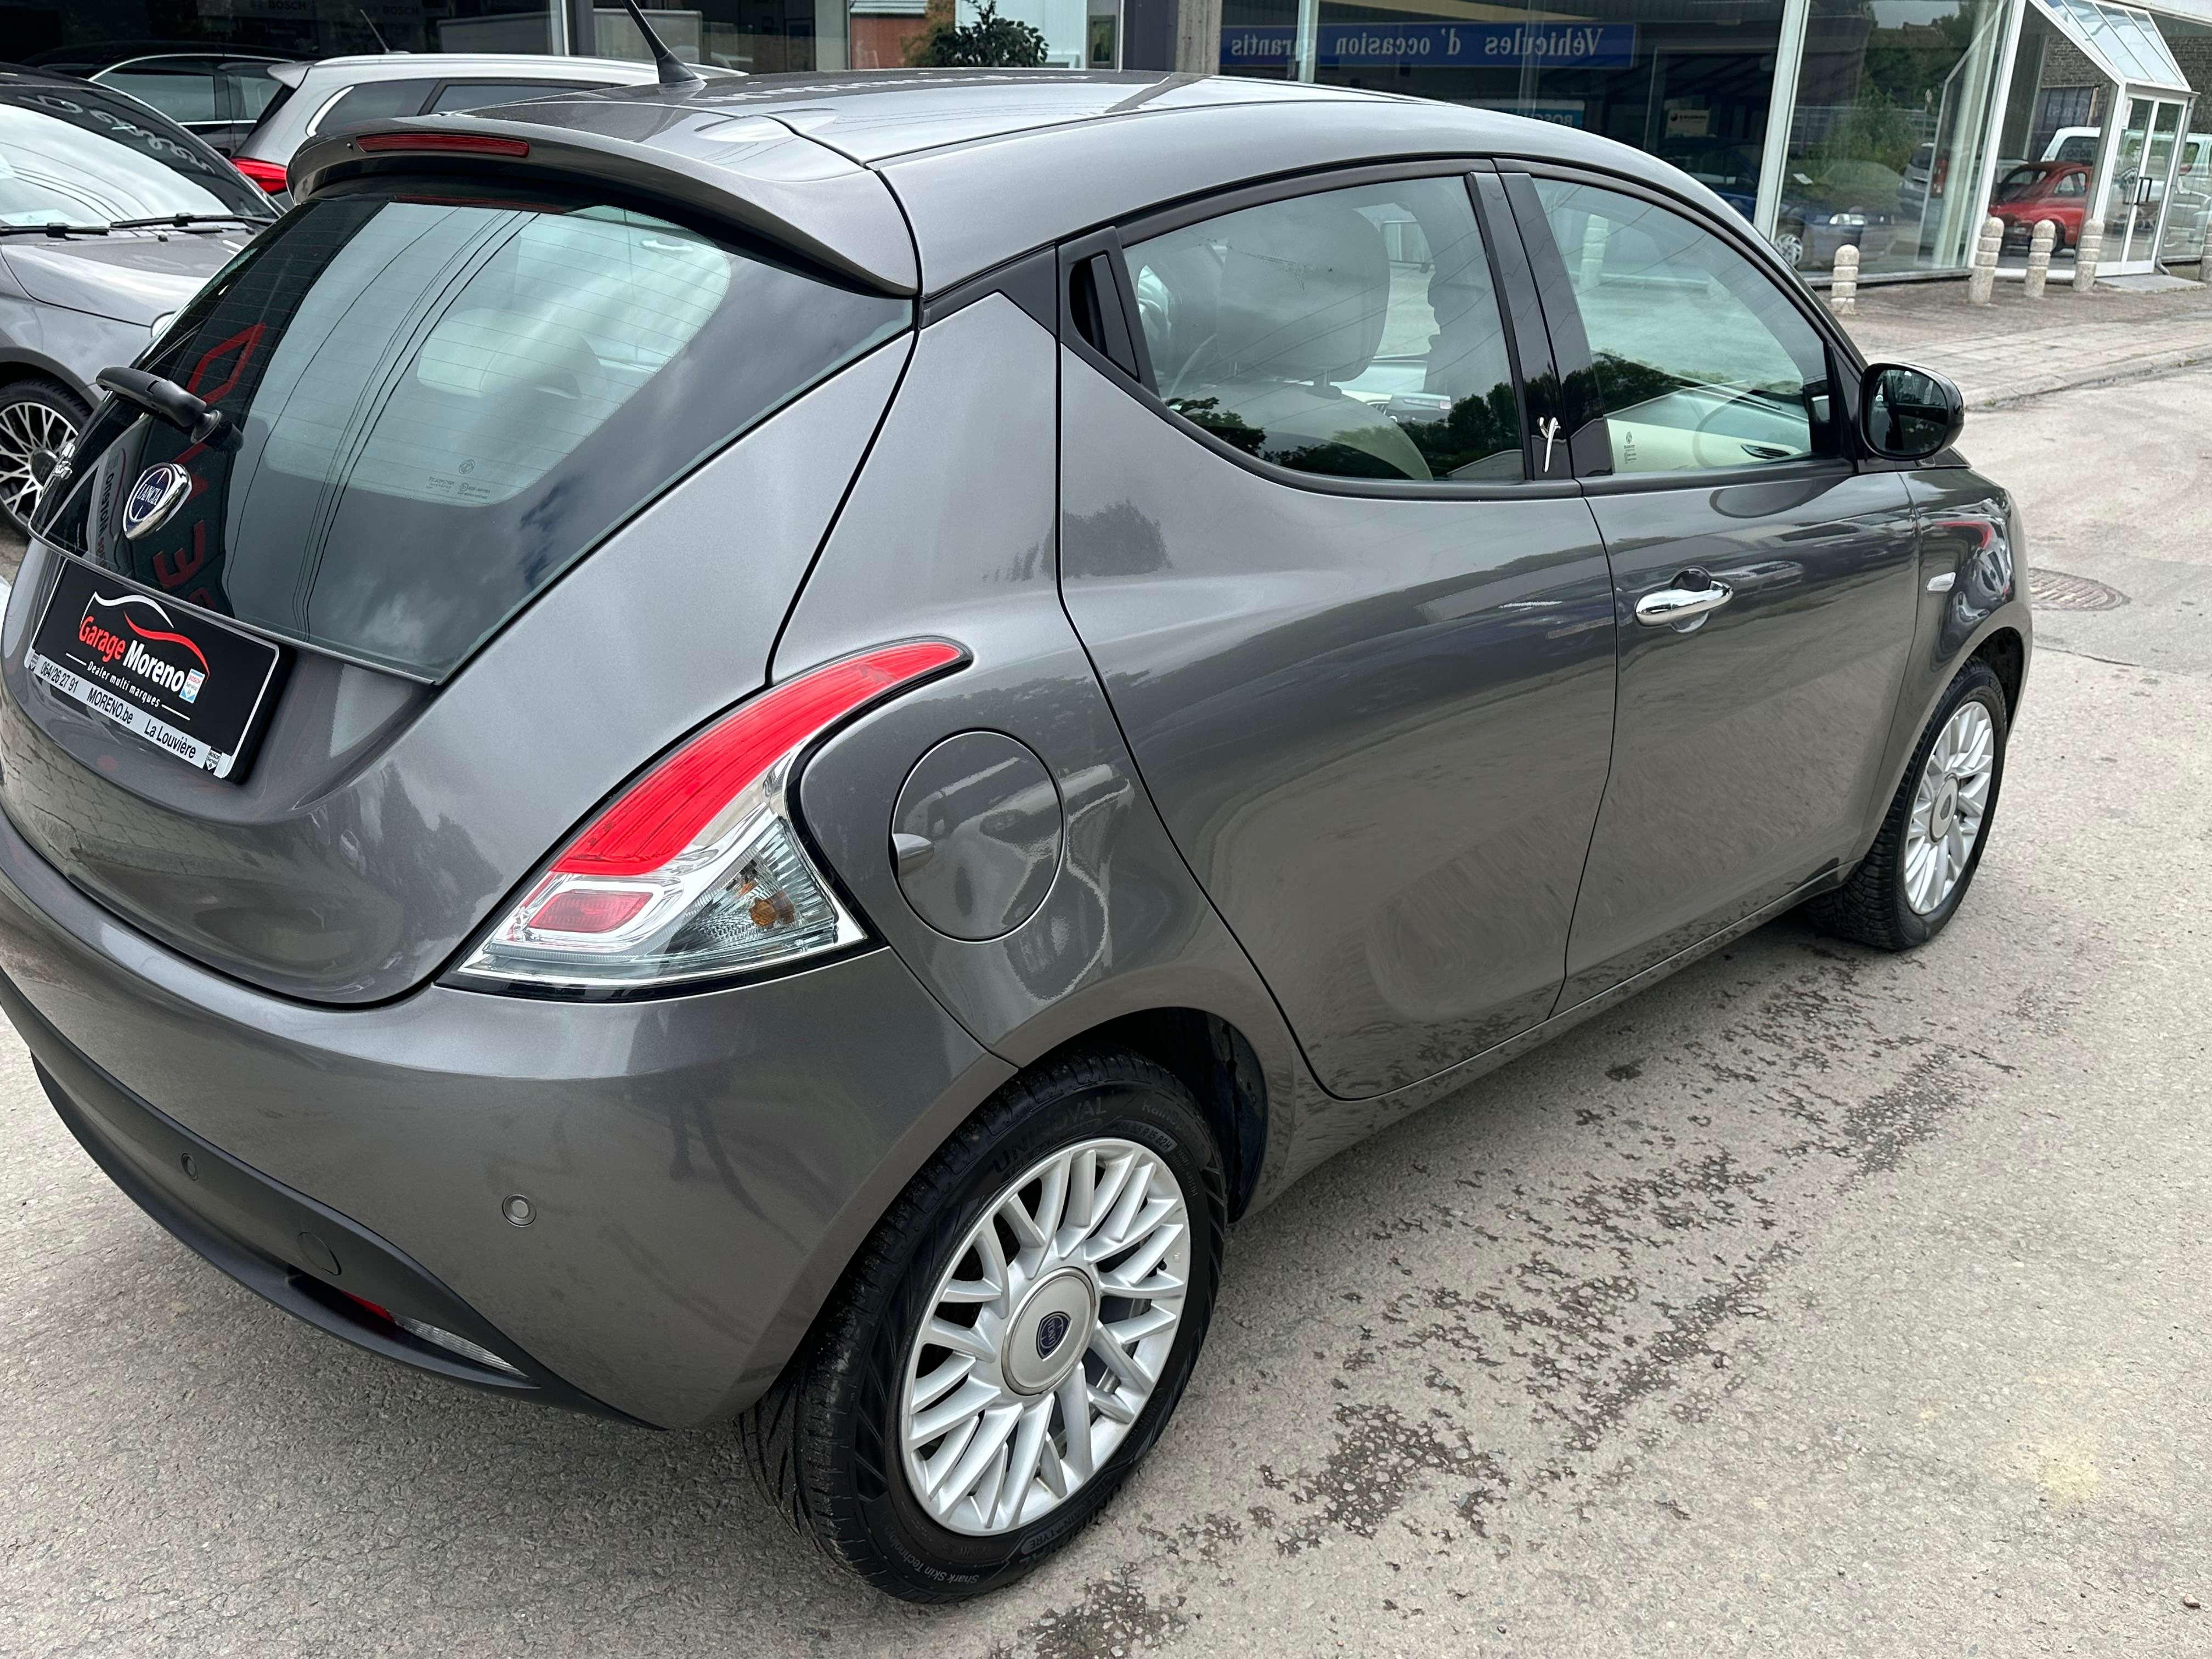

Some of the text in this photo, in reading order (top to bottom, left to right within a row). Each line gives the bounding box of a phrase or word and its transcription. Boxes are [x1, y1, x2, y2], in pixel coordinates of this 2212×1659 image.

[137, 483, 163, 505] LANCIA
[78, 616, 185, 692] Garage Moreno
[87, 661, 161, 708] Dealer multi marques
[59, 672, 70, 689] 27
[68, 677, 79, 693] 91
[86, 687, 134, 725] MORENO.be
[144, 719, 157, 738] La
[156, 725, 196, 759] Louvière
[924, 1565, 947, 1582] Skin
[947, 1573, 980, 1584] Shark
